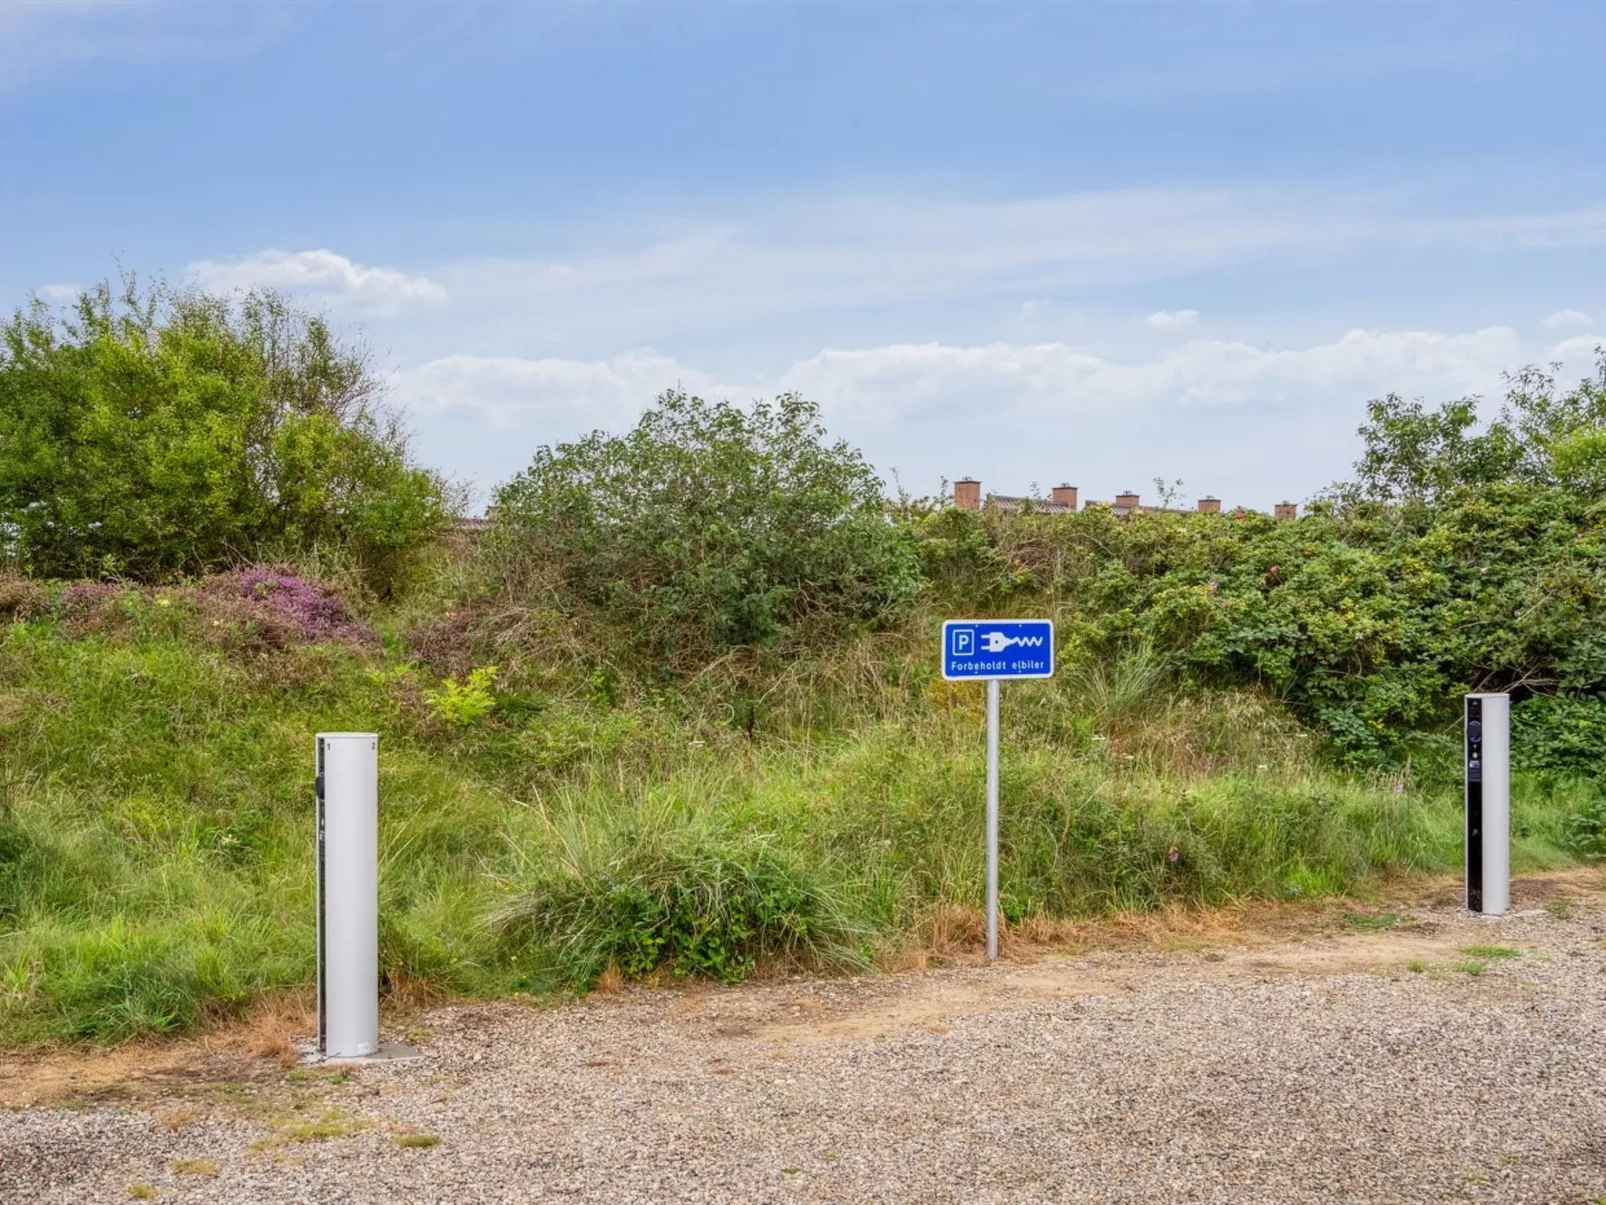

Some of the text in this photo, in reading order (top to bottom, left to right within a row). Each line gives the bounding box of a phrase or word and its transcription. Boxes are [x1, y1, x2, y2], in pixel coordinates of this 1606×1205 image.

[958, 634, 969, 650] P
[951, 660, 1044, 671] Forbeholdt elbiler
